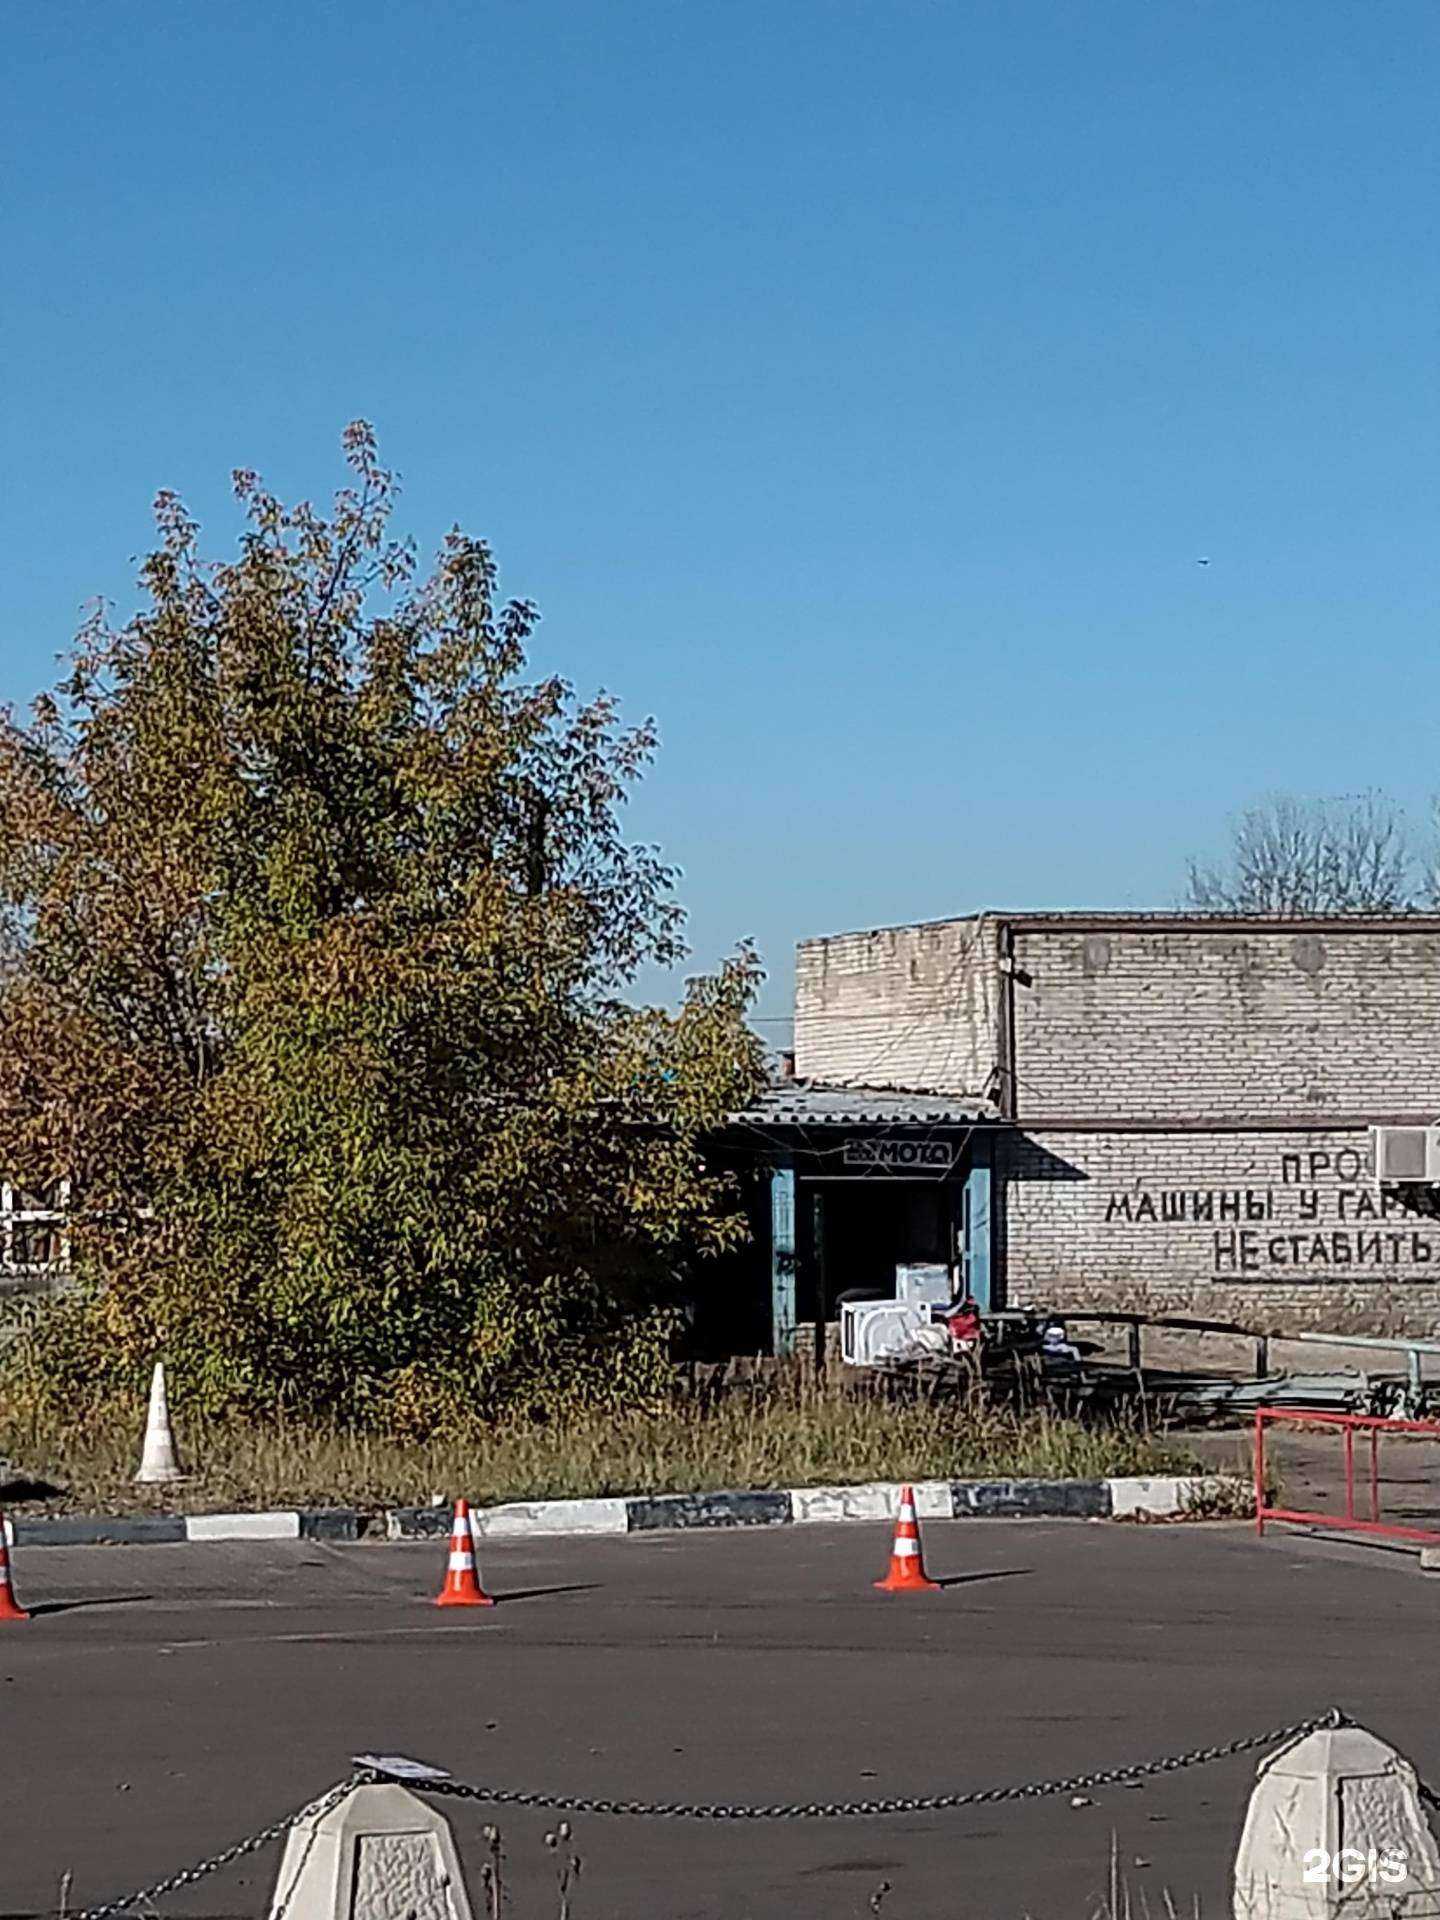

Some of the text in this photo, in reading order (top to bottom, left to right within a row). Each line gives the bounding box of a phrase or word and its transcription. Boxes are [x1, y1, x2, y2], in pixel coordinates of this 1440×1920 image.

[1281, 1150, 1362, 1183] ПРО
[1104, 1189, 1274, 1222] МАШИНЫ
[1299, 1189, 1320, 1219] У
